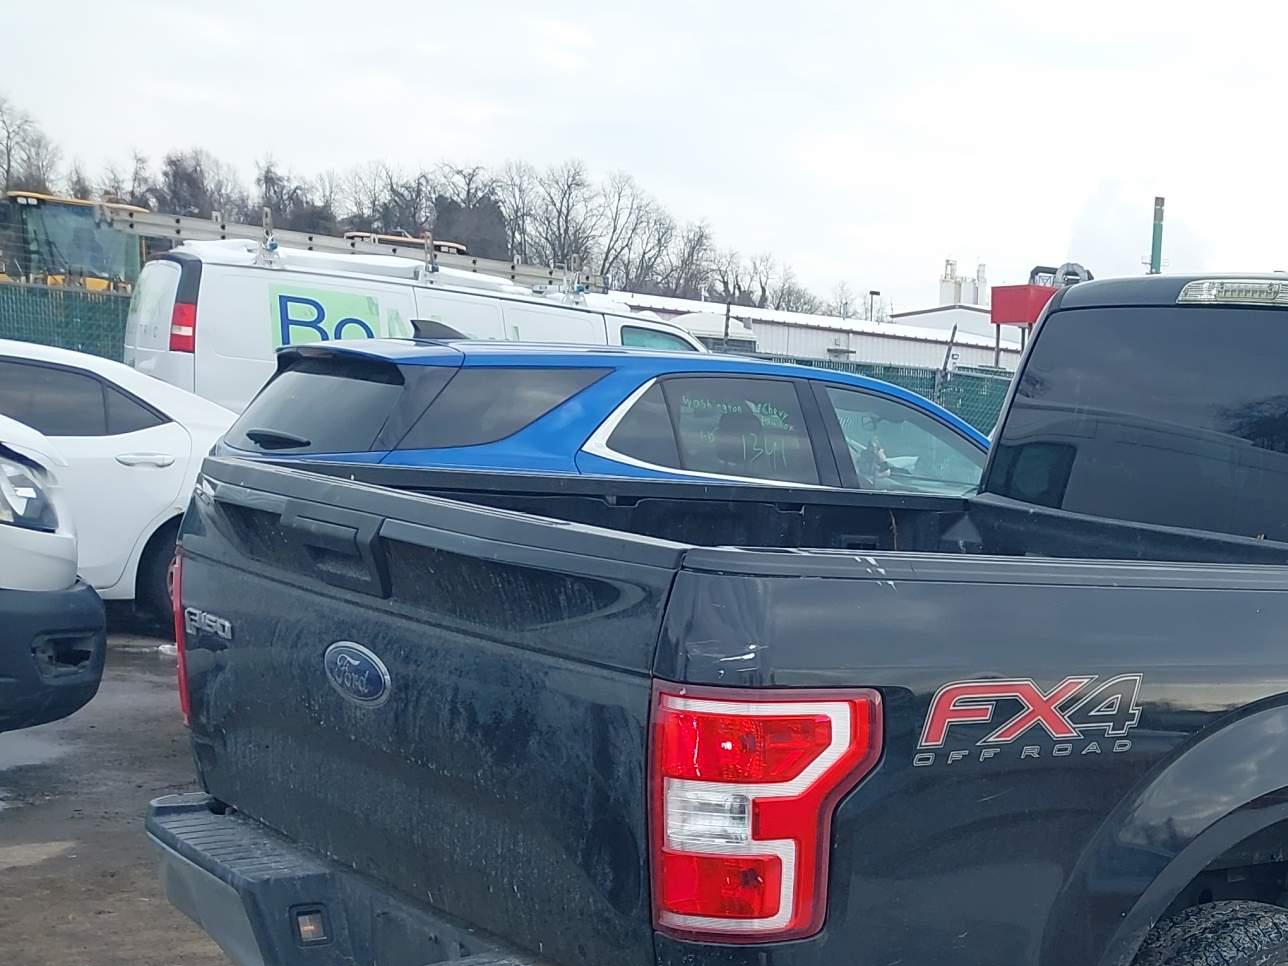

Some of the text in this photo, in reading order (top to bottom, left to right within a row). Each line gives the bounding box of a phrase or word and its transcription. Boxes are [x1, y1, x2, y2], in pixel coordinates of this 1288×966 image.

[335, 652, 370, 695] Ford
[916, 673, 1144, 749] FX4
[913, 739, 1133, 767] OFF ROAD
